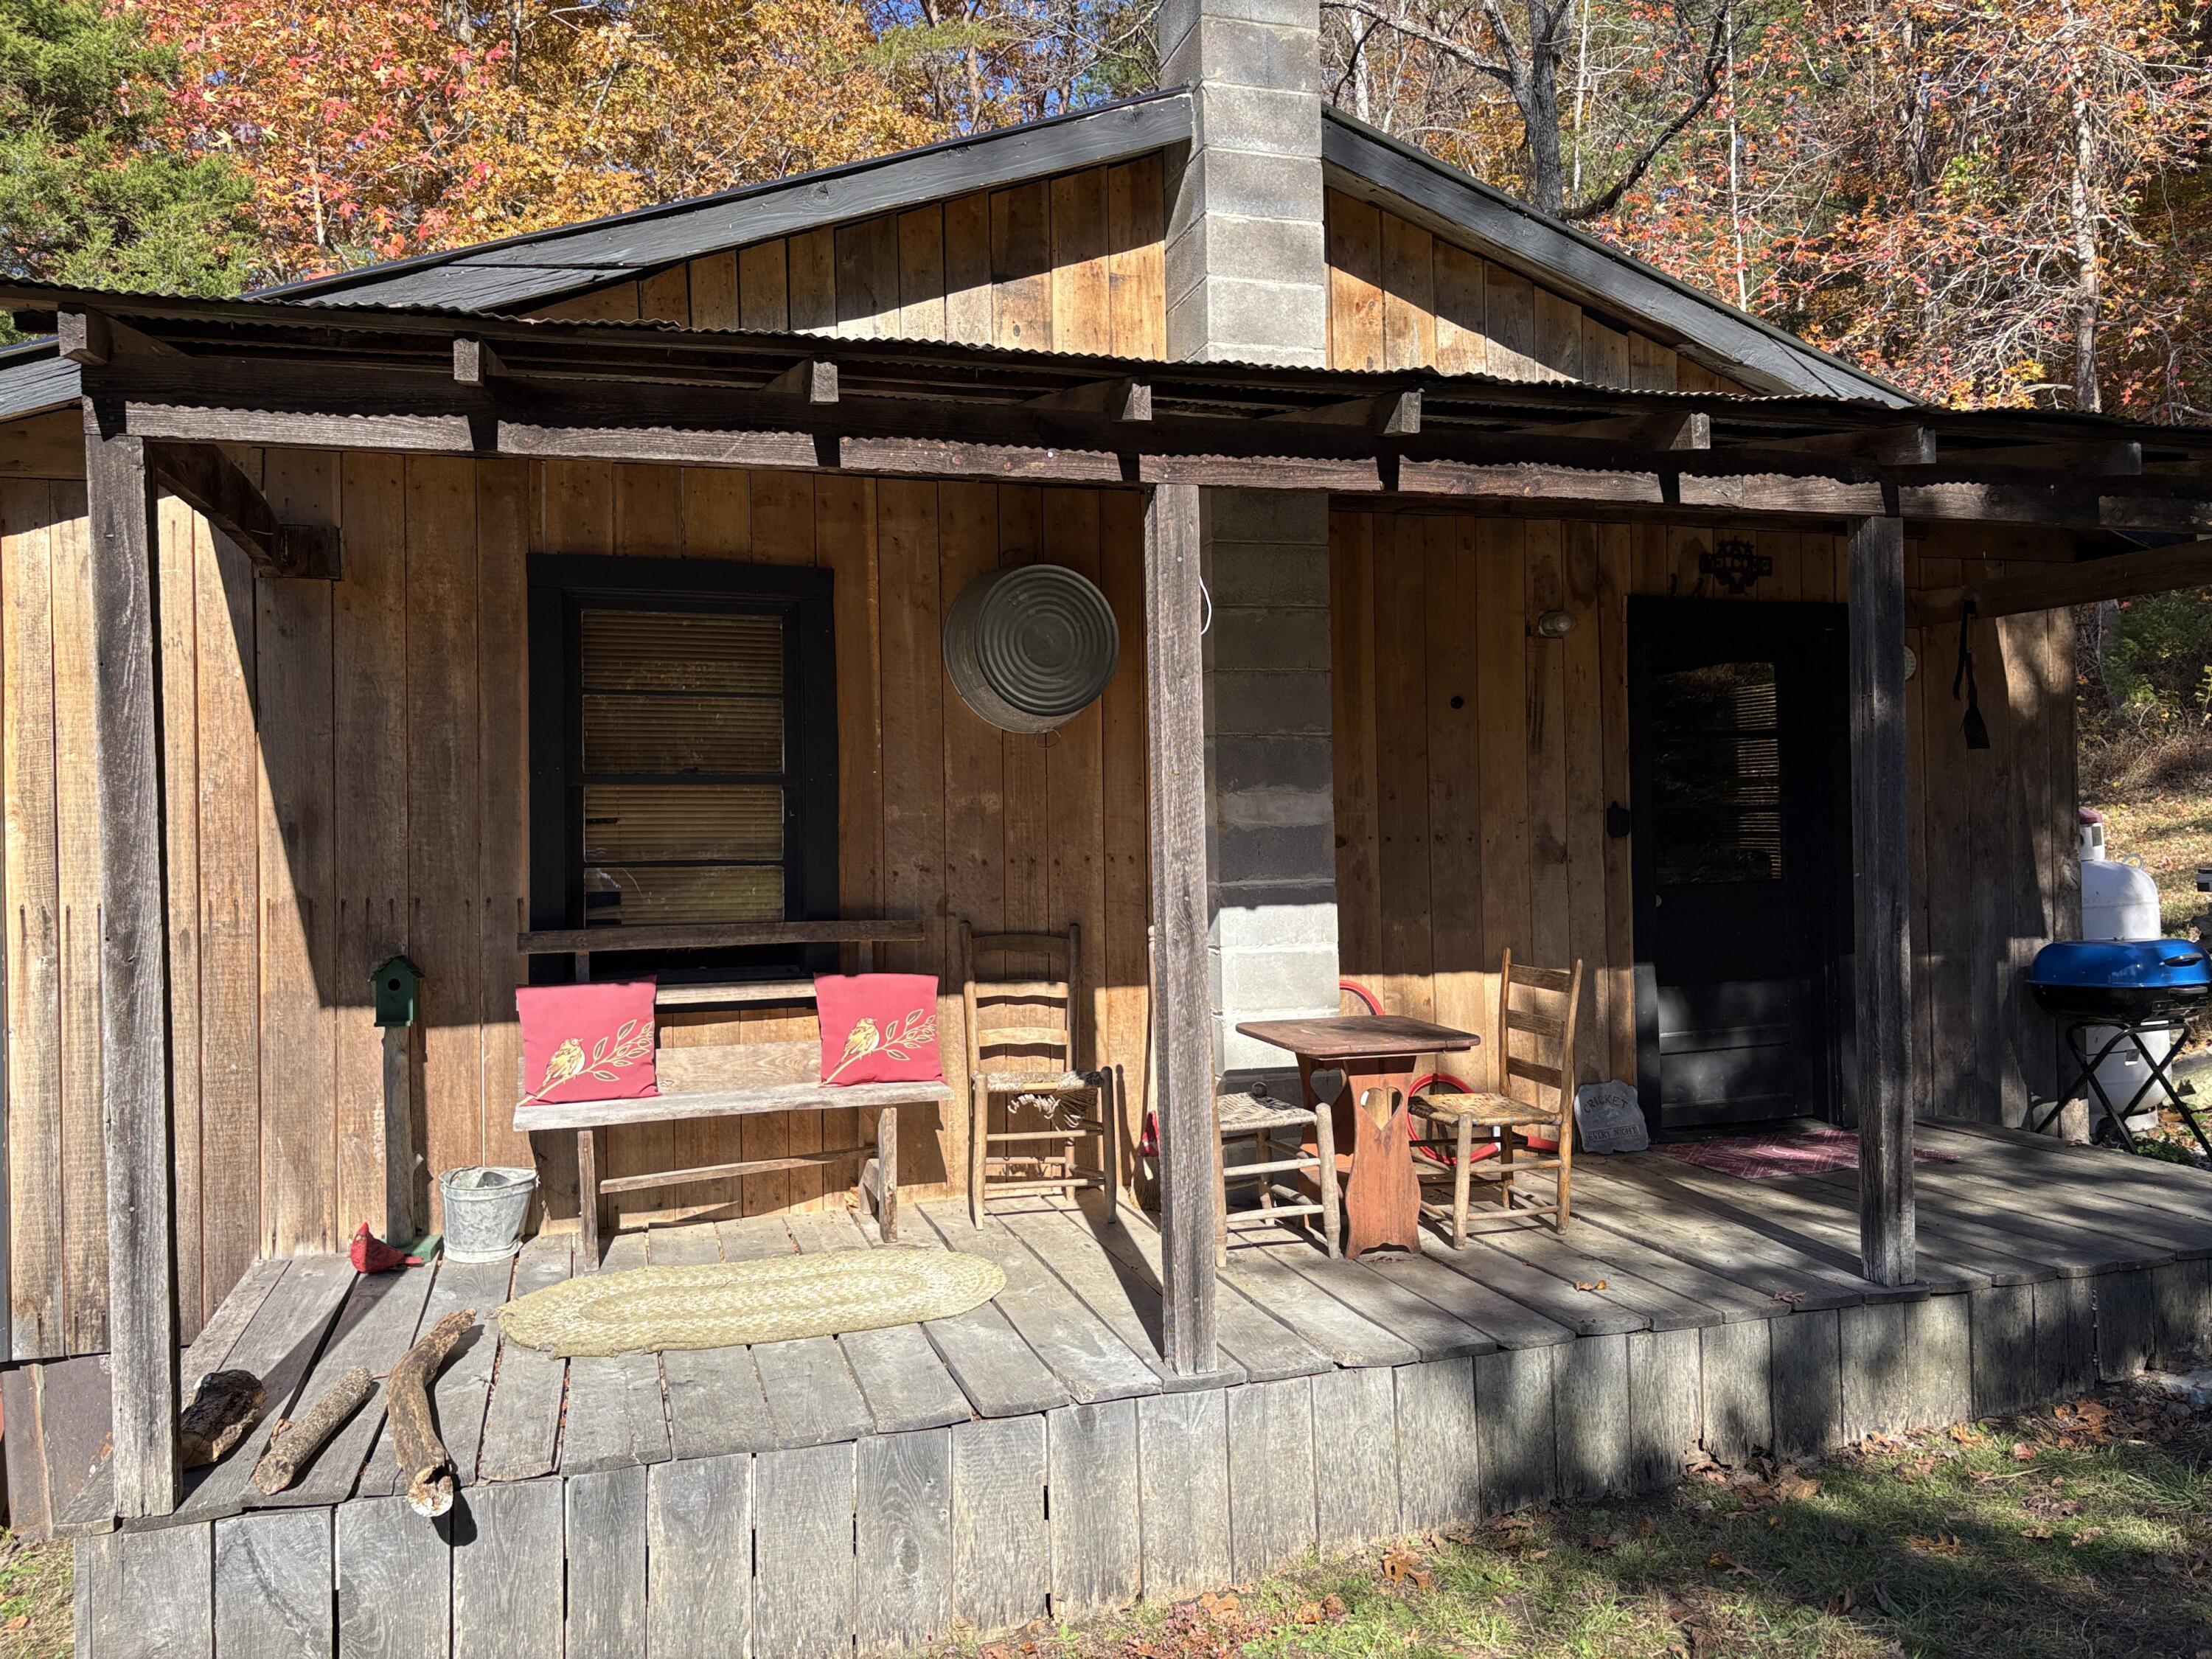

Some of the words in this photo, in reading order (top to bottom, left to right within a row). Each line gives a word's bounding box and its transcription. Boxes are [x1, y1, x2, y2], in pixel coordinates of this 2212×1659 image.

[1700, 556, 1770, 573] WELCOME
[1583, 1094, 1628, 1113] CRICKET
[1587, 1130, 1611, 1141] EVERY
[1613, 1127, 1637, 1136] NIGHT
